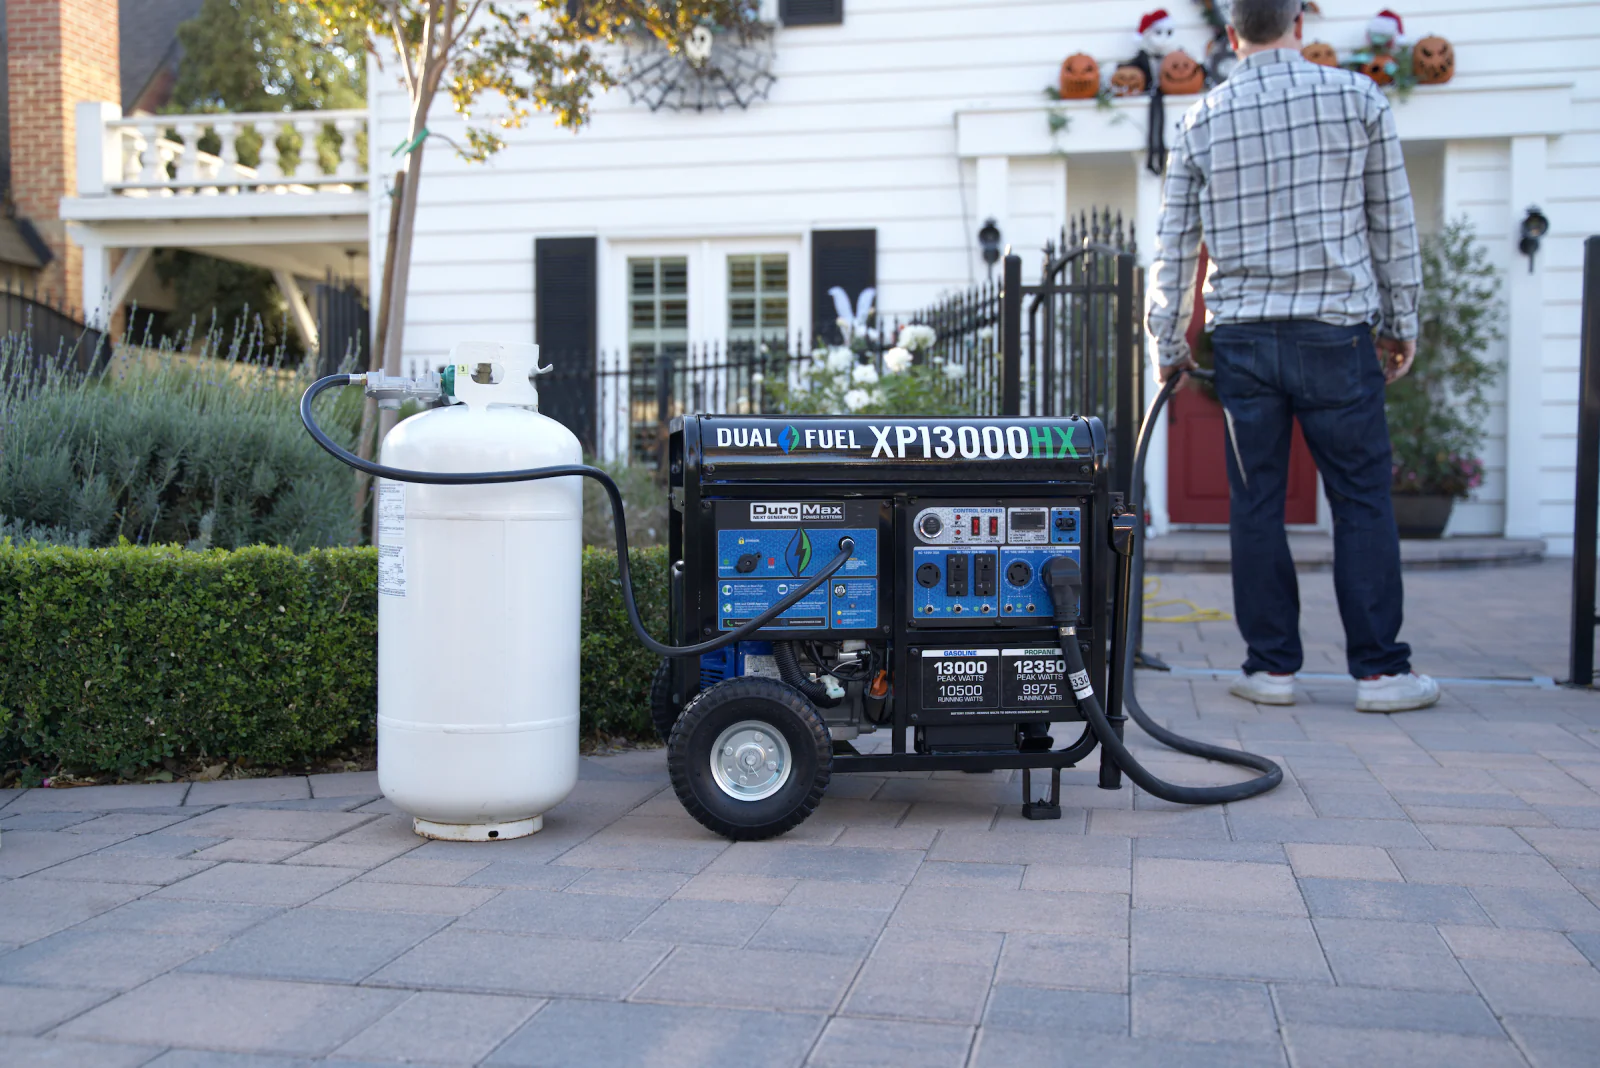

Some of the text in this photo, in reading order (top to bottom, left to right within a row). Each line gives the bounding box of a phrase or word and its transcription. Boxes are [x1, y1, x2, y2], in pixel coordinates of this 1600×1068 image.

[716, 428, 777, 448] DUAL
[805, 429, 861, 449] FUEL
[933, 661, 988, 675] 13000
[1013, 660, 1067, 674] 12350
[939, 685, 983, 696] 10500
[1022, 684, 1057, 695] 9975
